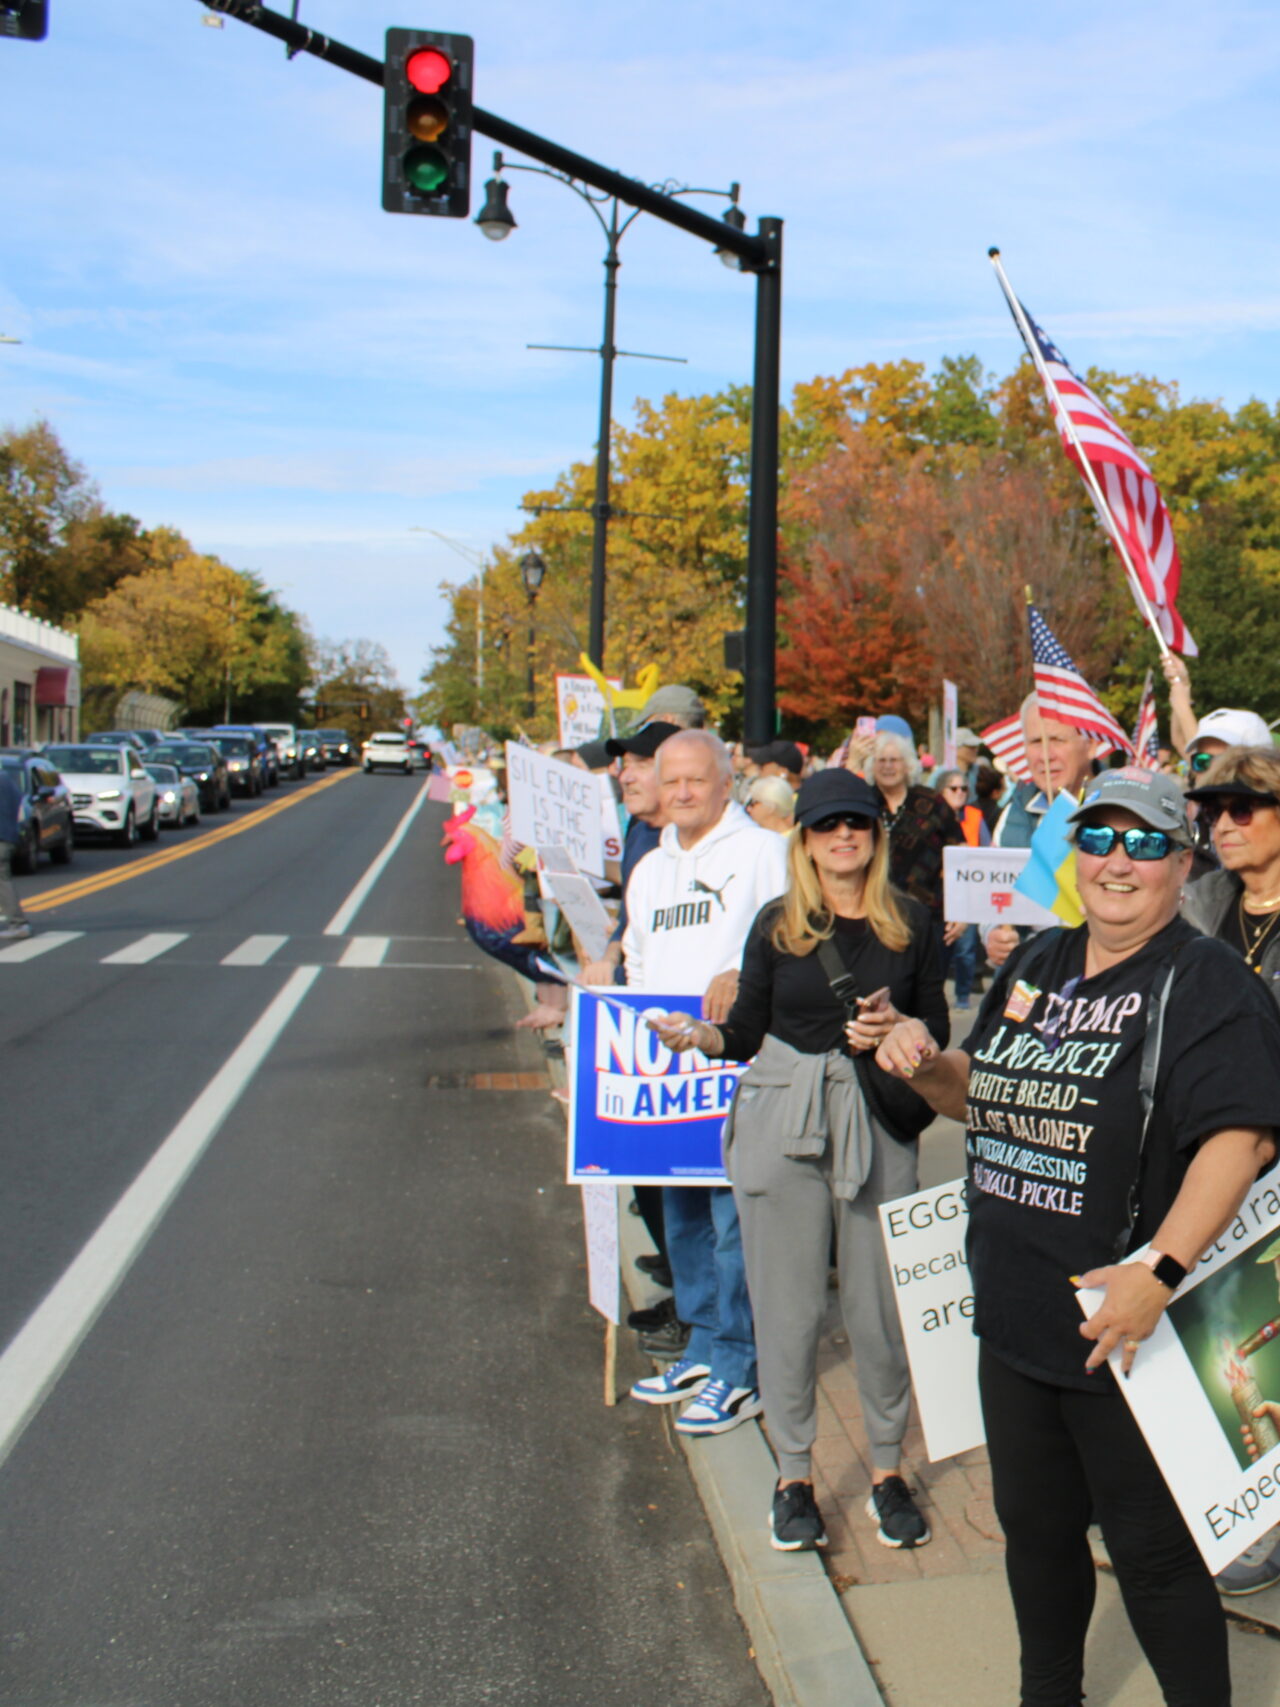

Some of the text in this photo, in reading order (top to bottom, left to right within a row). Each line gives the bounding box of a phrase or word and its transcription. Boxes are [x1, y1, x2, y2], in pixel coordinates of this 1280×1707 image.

[512, 753, 592, 810] SILENCE
[533, 792, 588, 837] IS THE
[534, 821, 588, 861] ENEMY
[956, 869, 985, 883] NO
[652, 900, 712, 933] PUMA
[596, 999, 673, 1077] NO
[604, 1086, 624, 1117] in
[968, 1070, 1018, 1104] WHITE
[1015, 1079, 1079, 1111] BREAD
[1013, 1146, 1088, 1185] DRESSING
[1018, 1180, 1083, 1216] PICKLE
[1232, 1213, 1249, 1240] a
[922, 1295, 976, 1332] are
